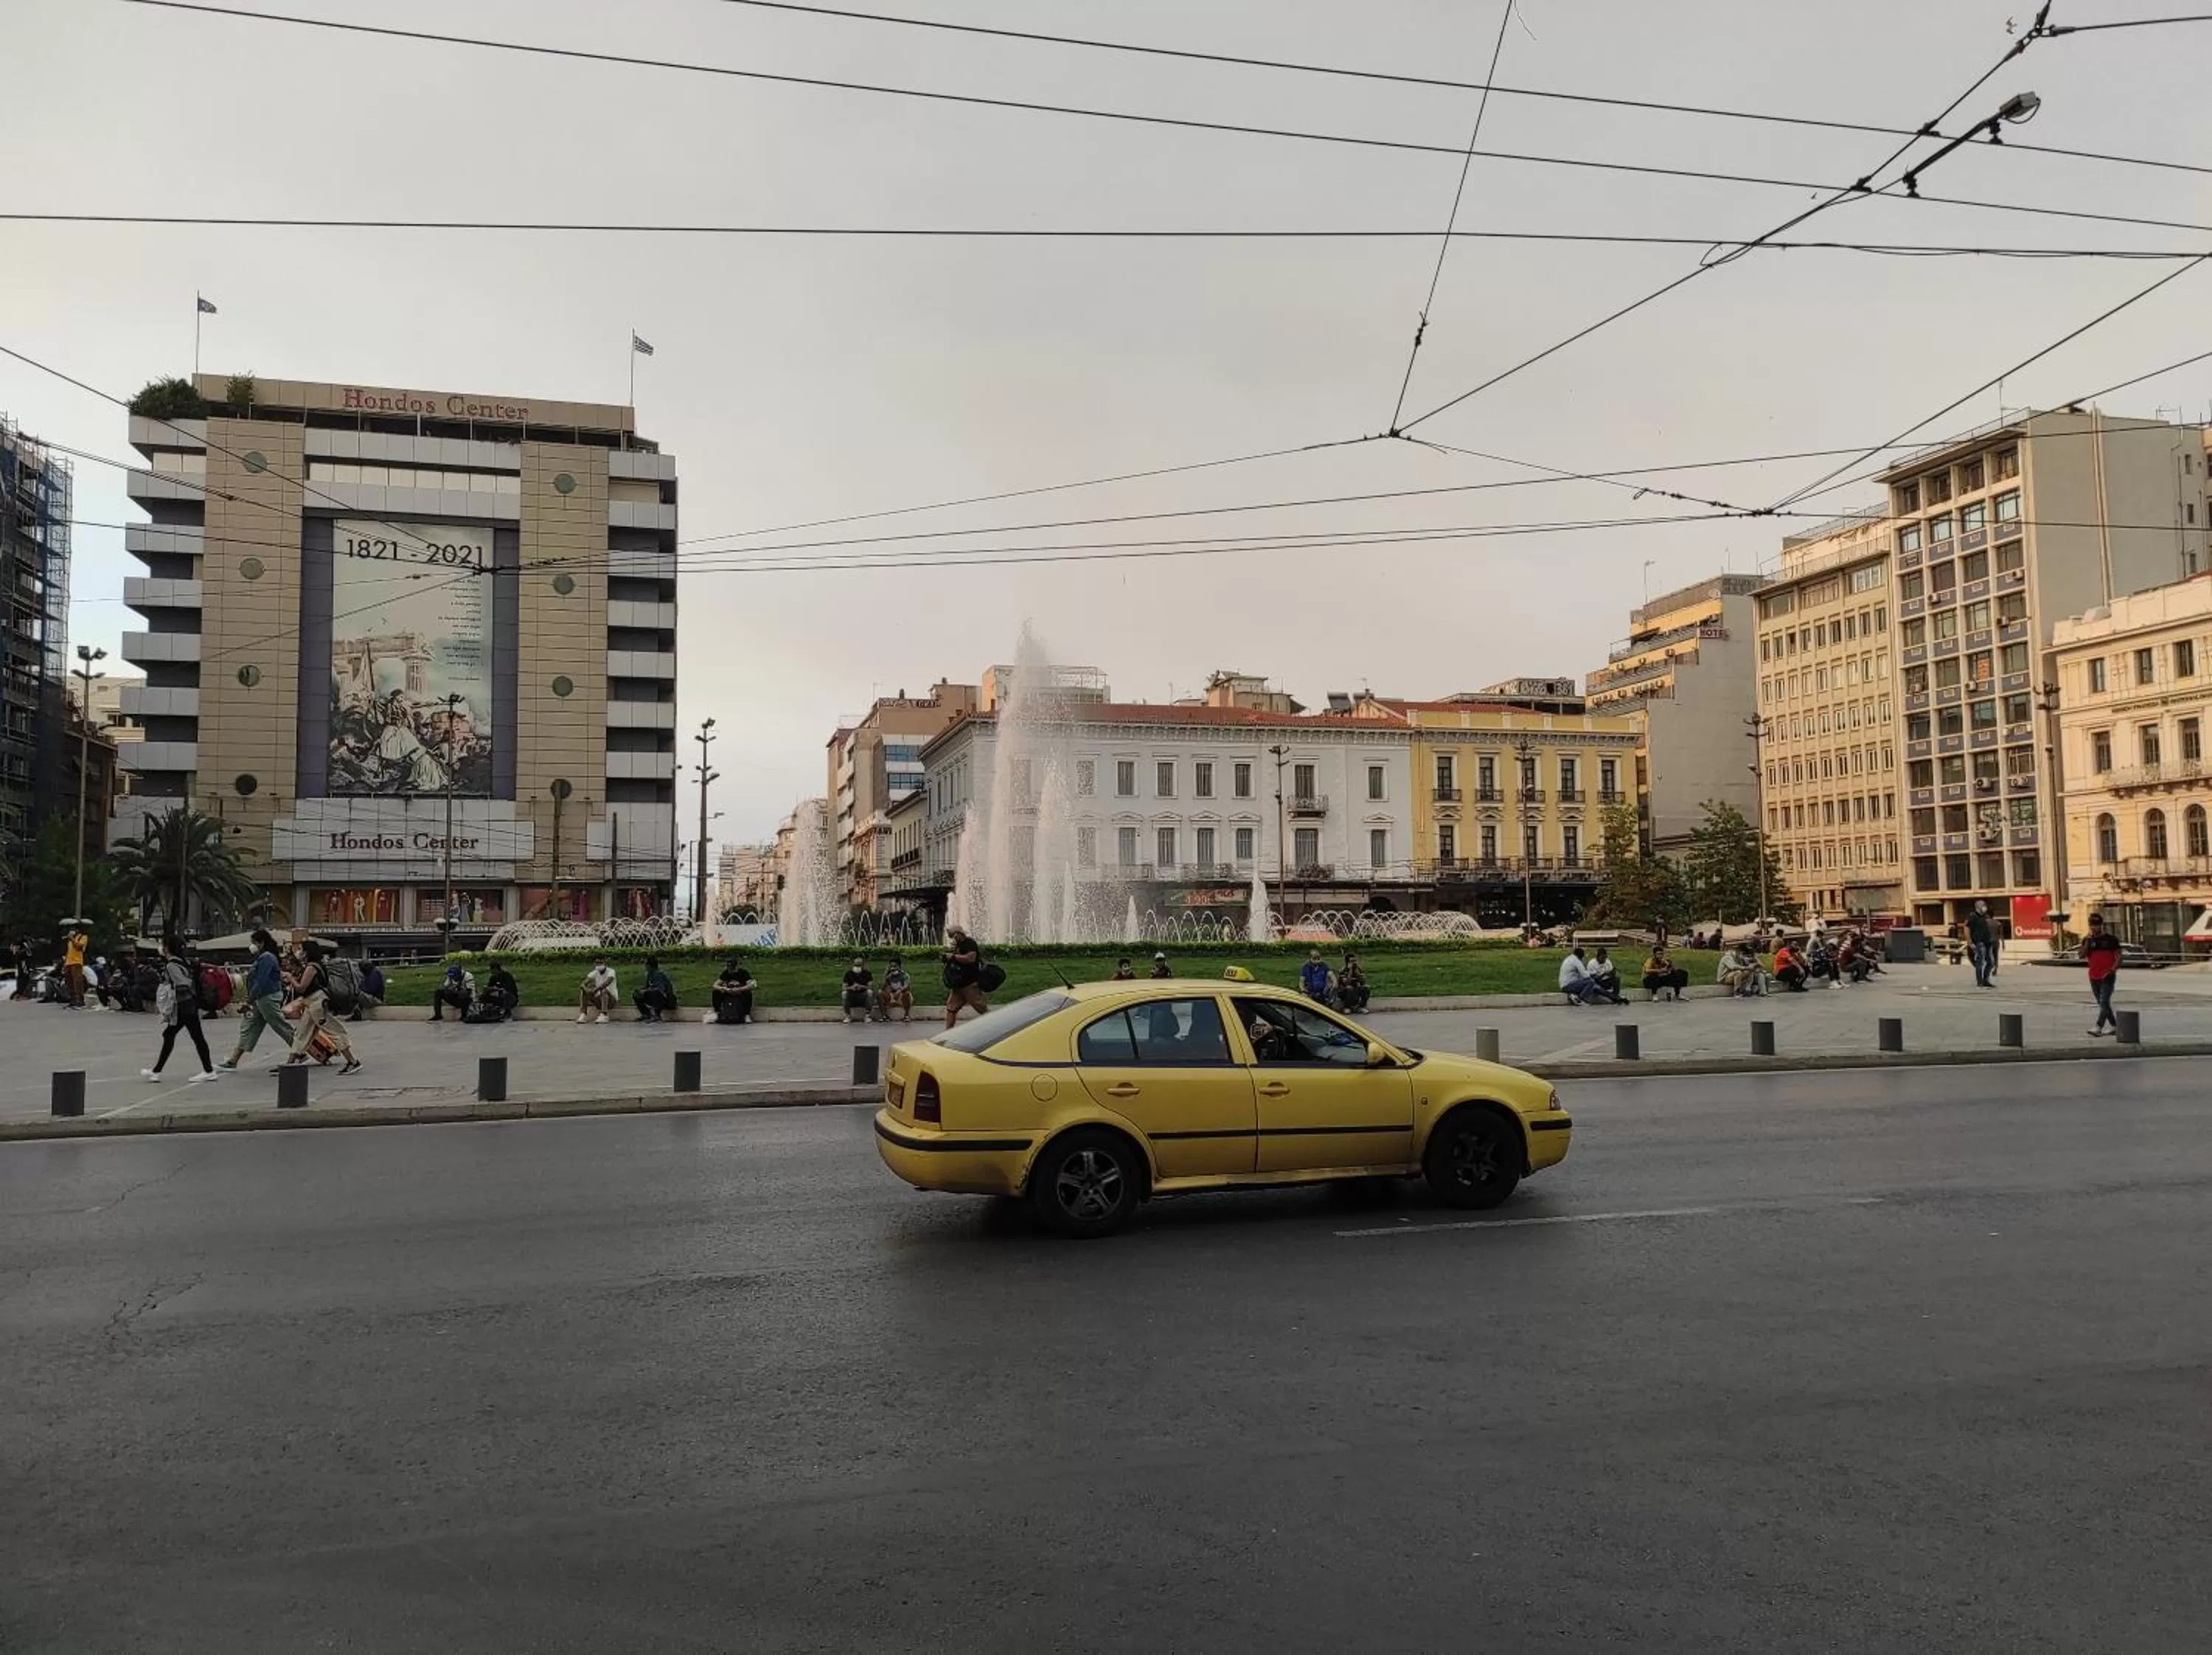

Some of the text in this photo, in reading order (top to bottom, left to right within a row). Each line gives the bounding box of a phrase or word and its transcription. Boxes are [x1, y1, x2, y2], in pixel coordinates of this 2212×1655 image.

[342, 389, 529, 420] Hondos Center
[347, 539, 397, 560] 1821
[426, 544, 483, 566] 2021
[330, 833, 403, 849] Hondos
